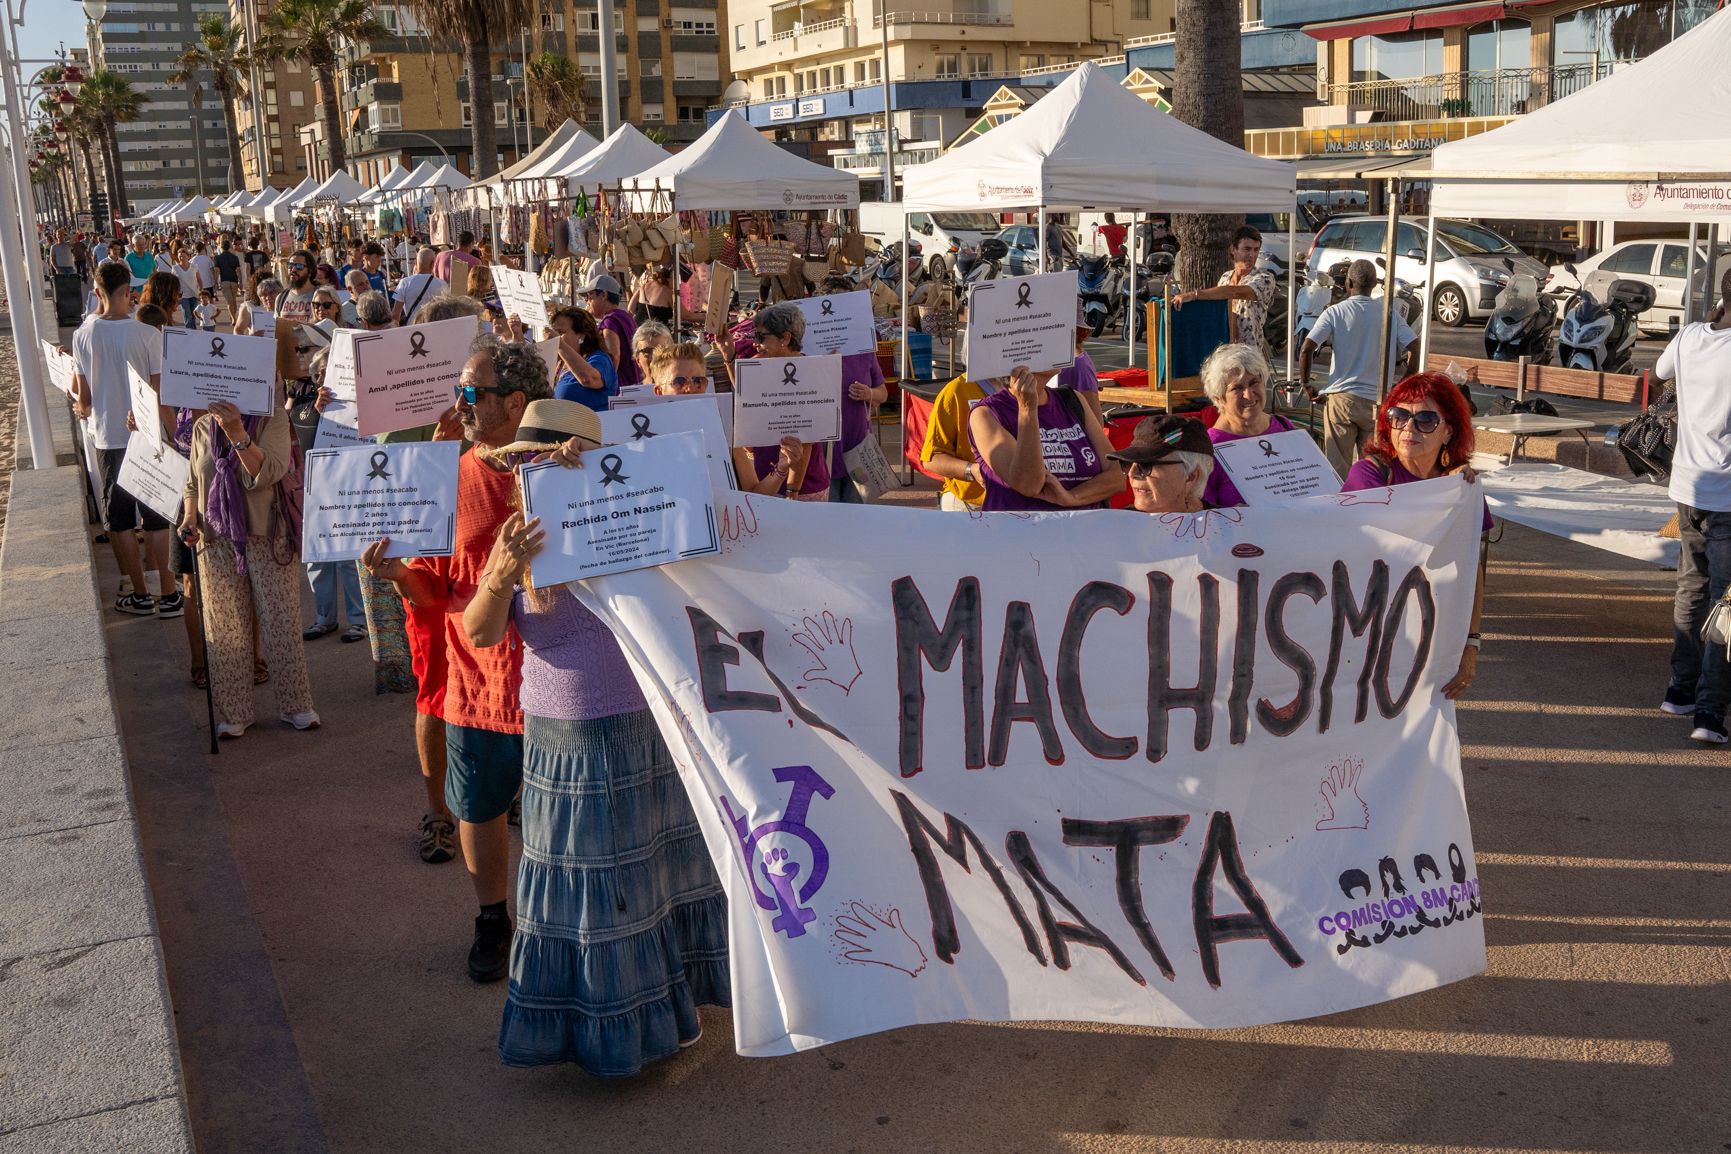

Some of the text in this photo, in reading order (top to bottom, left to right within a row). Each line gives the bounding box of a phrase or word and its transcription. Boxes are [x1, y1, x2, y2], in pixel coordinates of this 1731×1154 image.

[1325, 142, 1342, 152] UNA
[1396, 138, 1448, 149] GADITANA
[1654, 184, 1724, 201] Ayuntamiento
[426, 360, 451, 369] #seacabo
[192, 371, 222, 380] apellidos
[233, 376, 267, 384] conocidos
[369, 384, 387, 394] Amal
[437, 372, 462, 381] conoci
[354, 502, 385, 510] apellidos
[568, 485, 664, 510] Ni una menos #seacabo
[562, 501, 676, 530] Rachida Om Nassim
[626, 523, 639, 532] años
[587, 535, 617, 545] Asesinada
[618, 534, 628, 542] por
[638, 528, 656, 537] pareja
[616, 537, 650, 549] (Barcelona)
[580, 562, 598, 570] (fecha
[634, 553, 643, 561] del
[888, 788, 1305, 990] MATA
[1421, 887, 1450, 910] 8M
